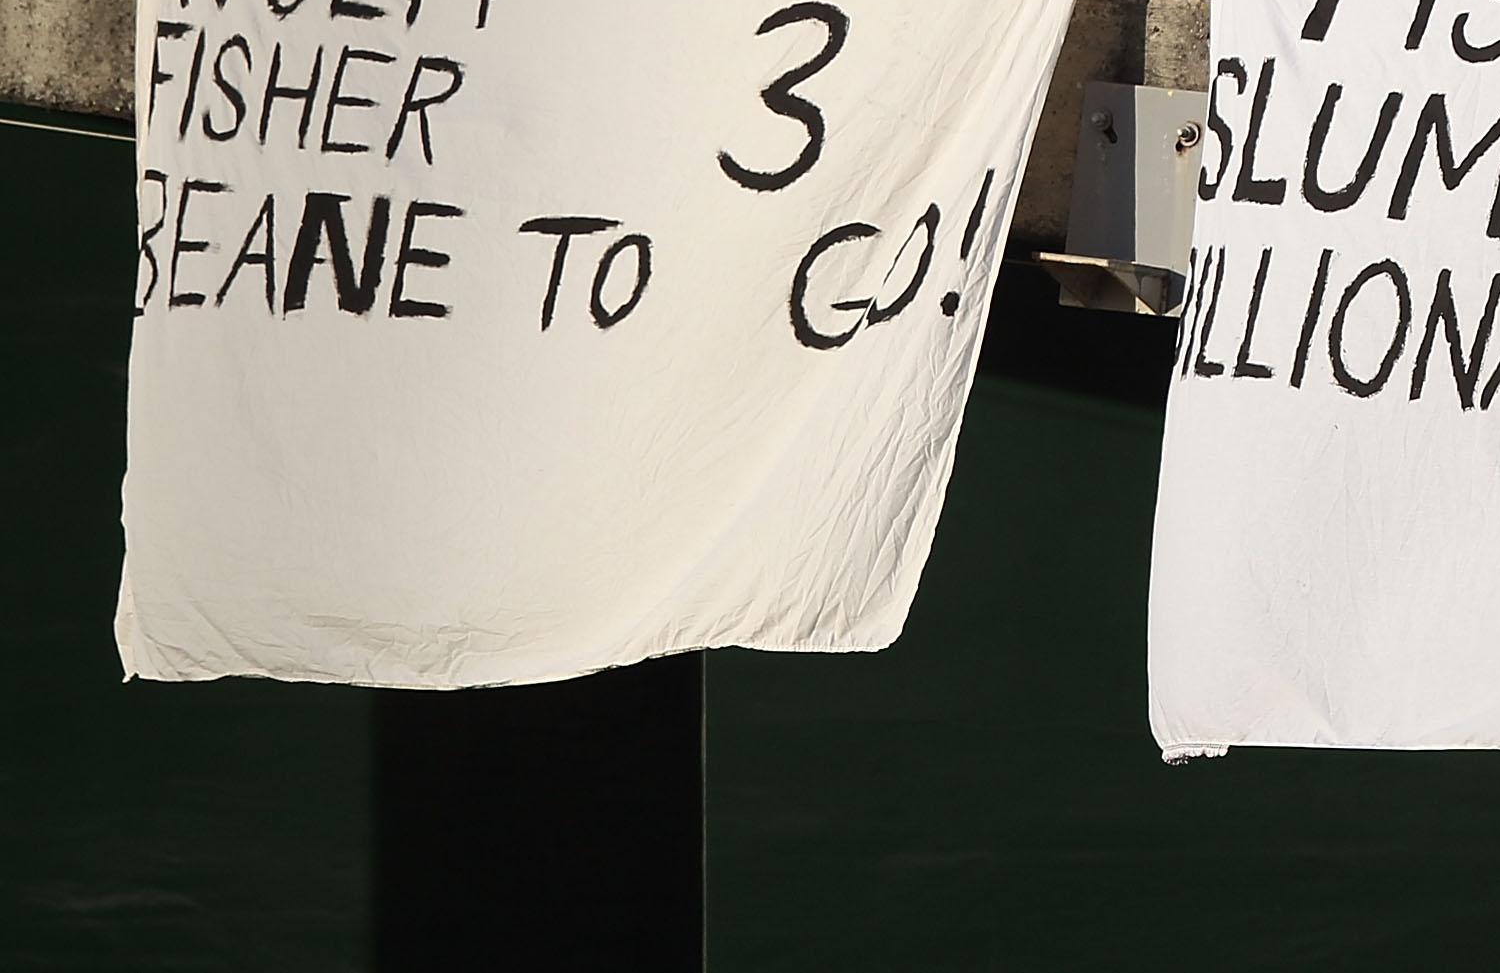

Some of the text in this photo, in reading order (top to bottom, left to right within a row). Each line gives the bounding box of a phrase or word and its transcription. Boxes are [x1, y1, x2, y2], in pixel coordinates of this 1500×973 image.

[148, 1, 849, 192] FISHER 3
[518, 216, 653, 332] TO
[788, 168, 996, 351] GO!
